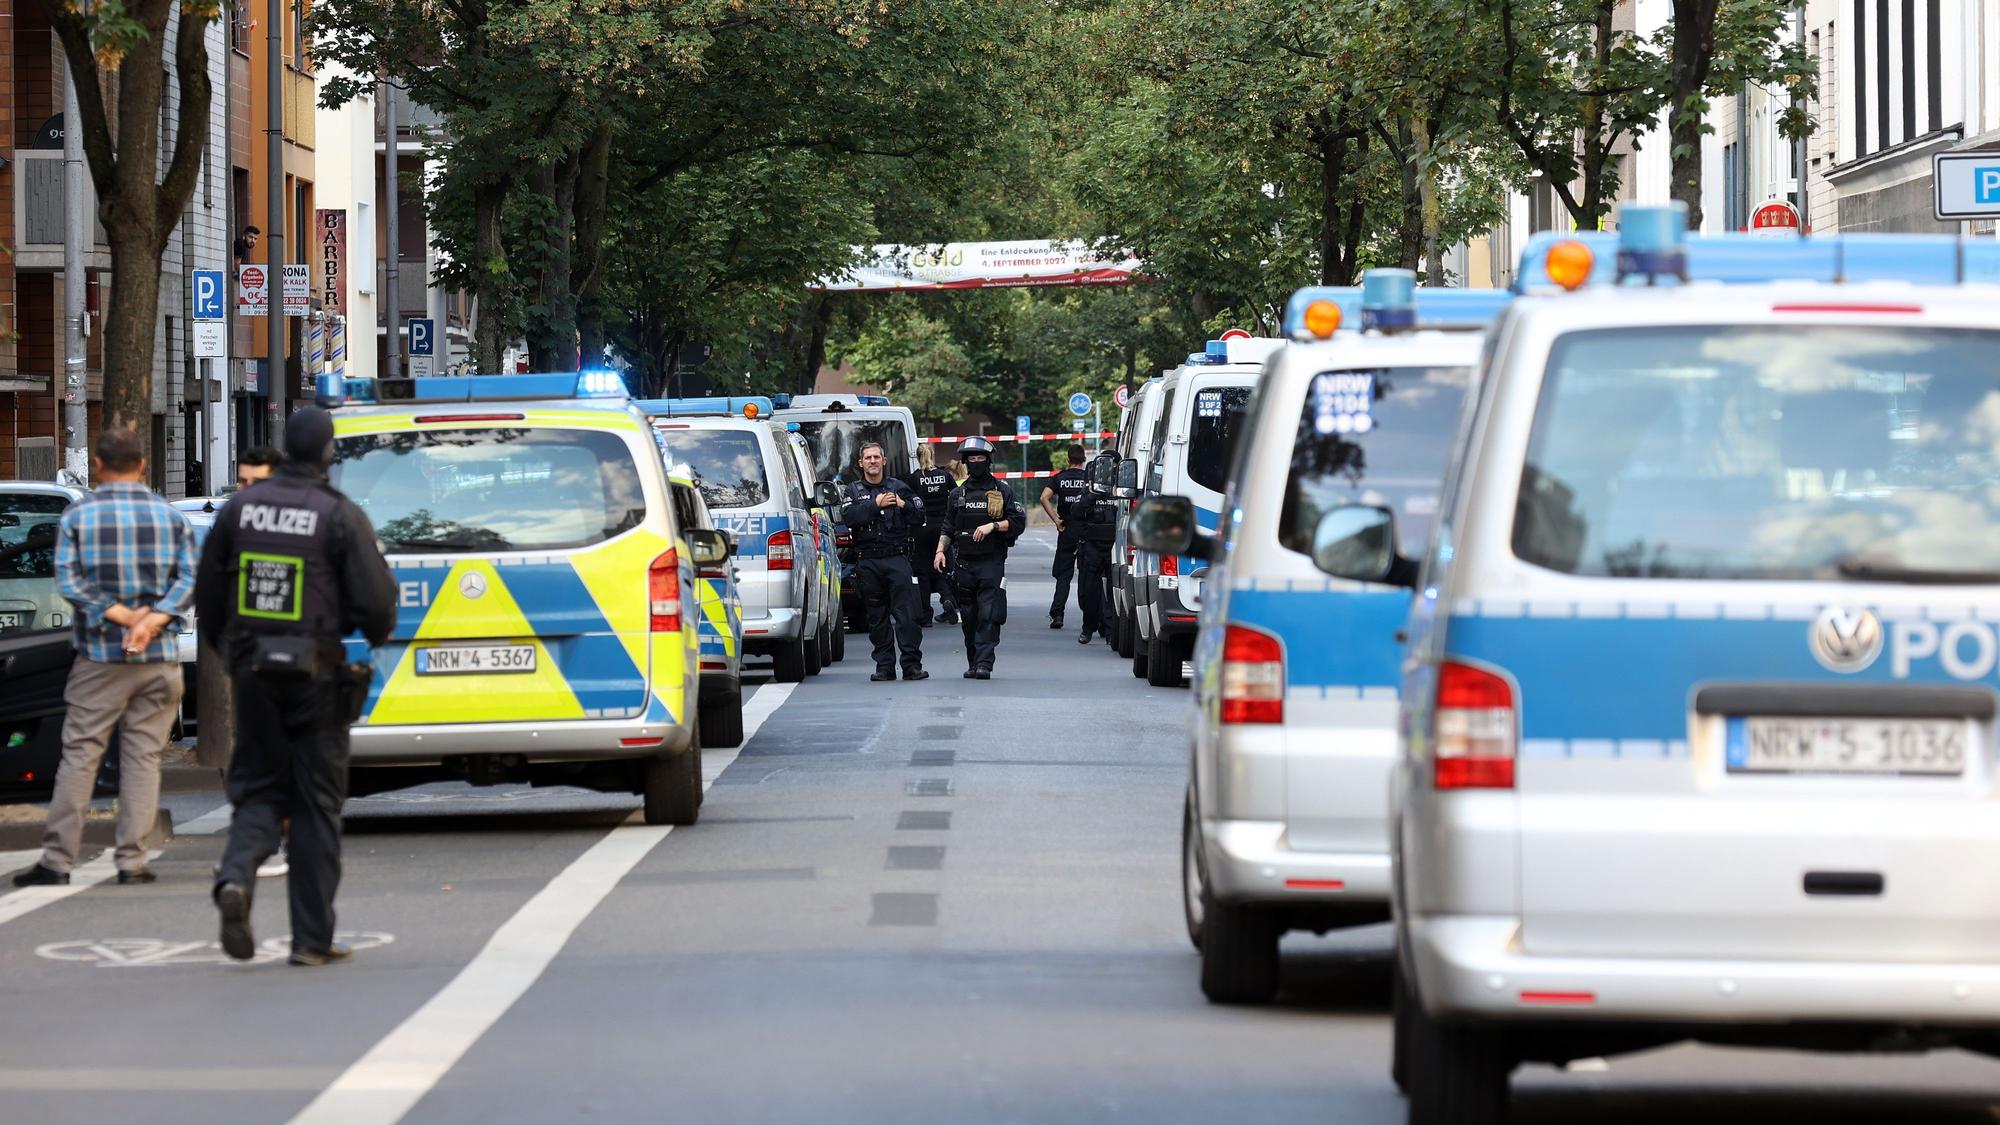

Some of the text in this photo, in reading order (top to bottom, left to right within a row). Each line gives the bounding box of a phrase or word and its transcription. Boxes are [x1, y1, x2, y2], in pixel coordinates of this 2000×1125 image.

[1982, 171, 2000, 199] P
[323, 214, 340, 306] BARBER
[981, 248, 997, 256] Eine
[993, 258, 1041, 267] SEPTEMBER
[1044, 257, 1066, 266] 2022
[282, 267, 307, 277] RONA
[198, 276, 215, 312] P
[412, 323, 426, 351] P
[1199, 392, 1221, 401] NRW
[1199, 401, 1205, 409] 3
[1215, 401, 1221, 409] 2
[920, 475, 946, 485] POLIZEI
[240, 504, 318, 536] POLIZEI
[395, 580, 429, 608] EI
[52, 613, 62, 628] D
[427, 650, 460, 670] NRW
[1891, 621, 2000, 681] PO
[1752, 723, 1815, 759] NRW
